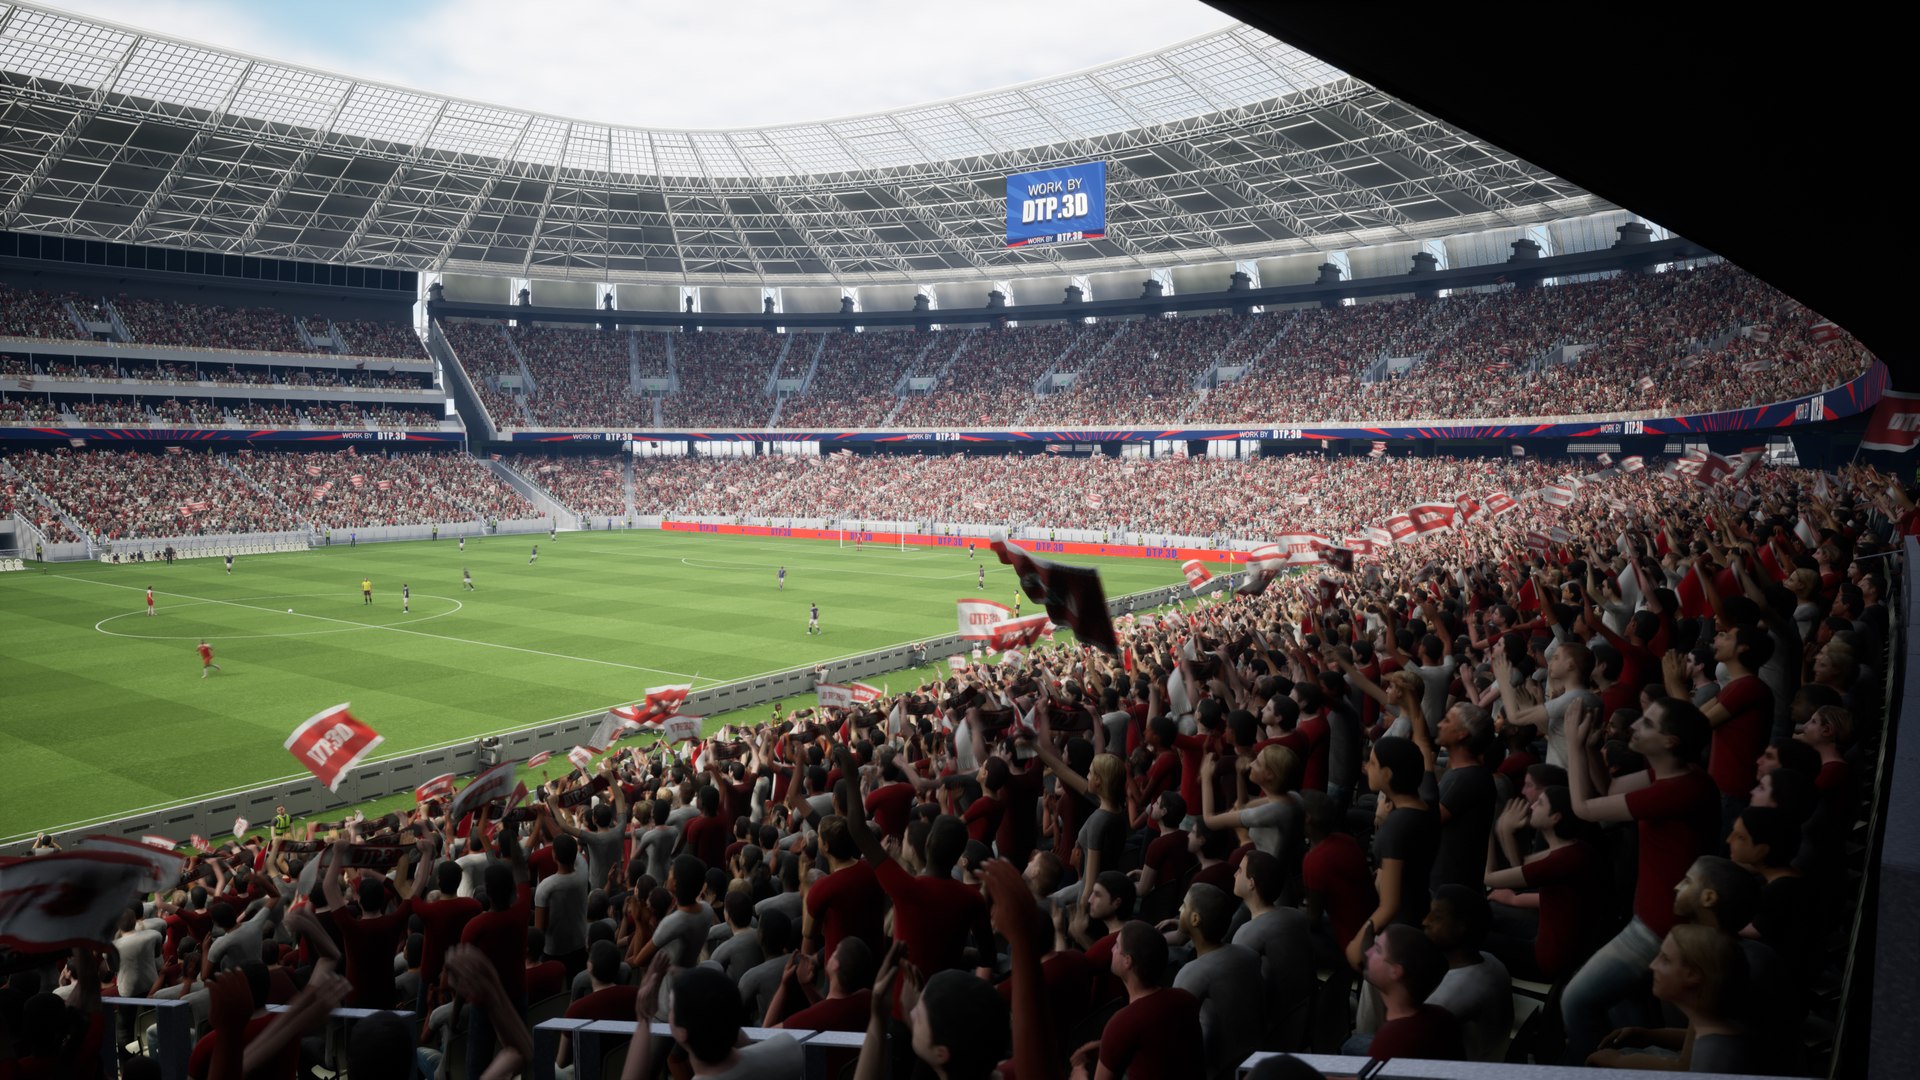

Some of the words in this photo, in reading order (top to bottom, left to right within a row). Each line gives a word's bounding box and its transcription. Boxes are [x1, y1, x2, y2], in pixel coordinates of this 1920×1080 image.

[1028, 181, 1063, 196] WORK
[1067, 177, 1083, 191] BY
[1022, 193, 1088, 223] DTP.3D
[1057, 231, 1083, 242] DTP.3D
[377, 431, 407, 440] DTP.3D
[935, 432, 961, 440] DTP.3D
[1273, 429, 1302, 439] DTP.3D
